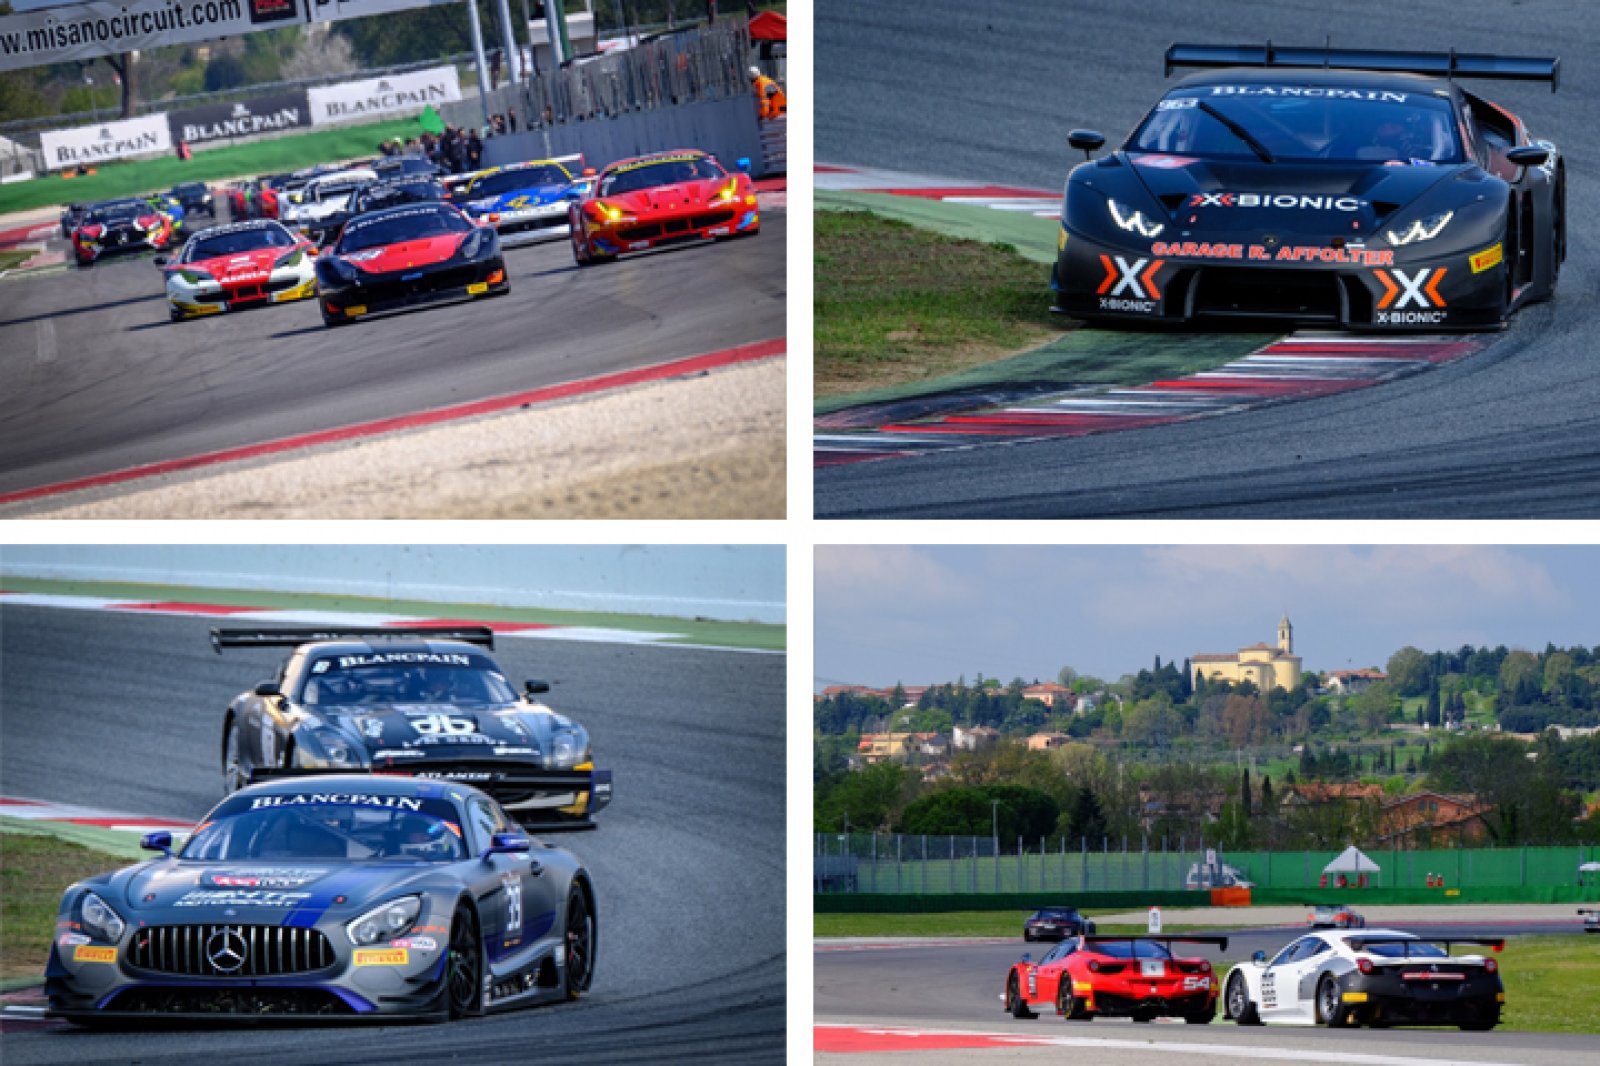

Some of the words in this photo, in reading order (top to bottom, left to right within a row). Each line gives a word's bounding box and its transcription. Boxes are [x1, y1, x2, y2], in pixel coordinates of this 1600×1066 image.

[325, 83, 446, 117] BLANCPAIN
[1212, 85, 1407, 103] BLANCPAIN
[183, 108, 298, 141] BLANCPAIN
[57, 132, 157, 162] BLANCPAIN
[1152, 242, 1243, 259] GARAGE
[1248, 245, 1271, 260] R.
[1275, 246, 1394, 266] AFFOLTER
[339, 653, 470, 667] BLANCPAIN
[250, 794, 422, 811] BLANCPAIN
[1183, 976, 1210, 991] 54
